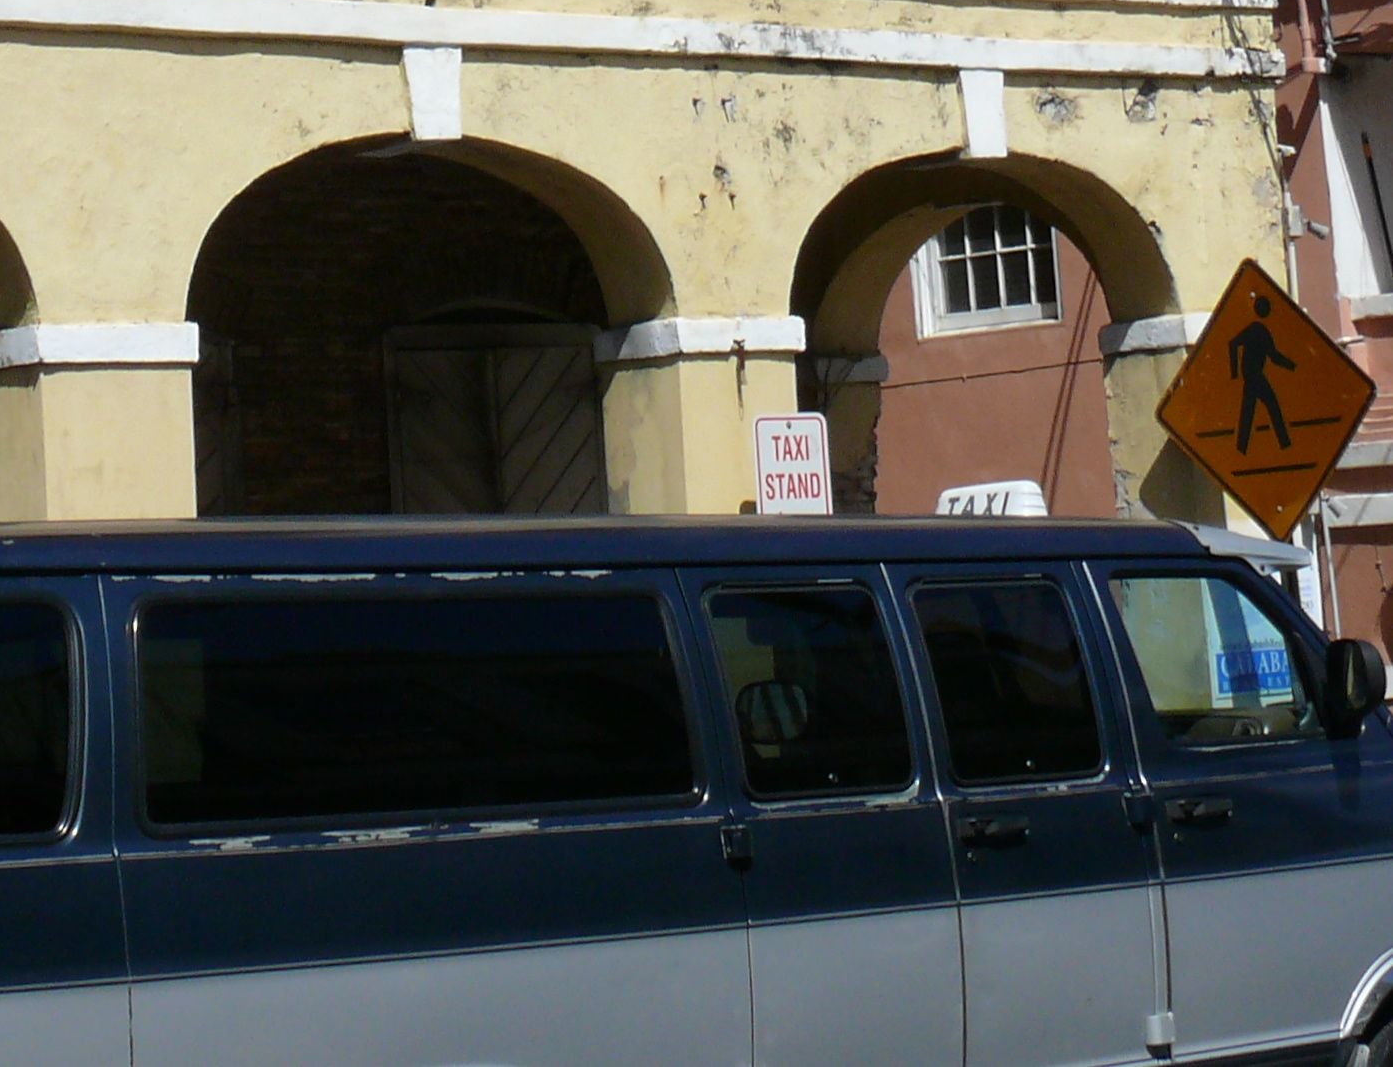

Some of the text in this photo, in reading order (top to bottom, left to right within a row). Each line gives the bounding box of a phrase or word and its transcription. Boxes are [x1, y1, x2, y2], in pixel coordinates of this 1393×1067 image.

[771, 435, 810, 462] TAXI
[765, 473, 821, 500] STAND
[948, 492, 1010, 516] TAXI
